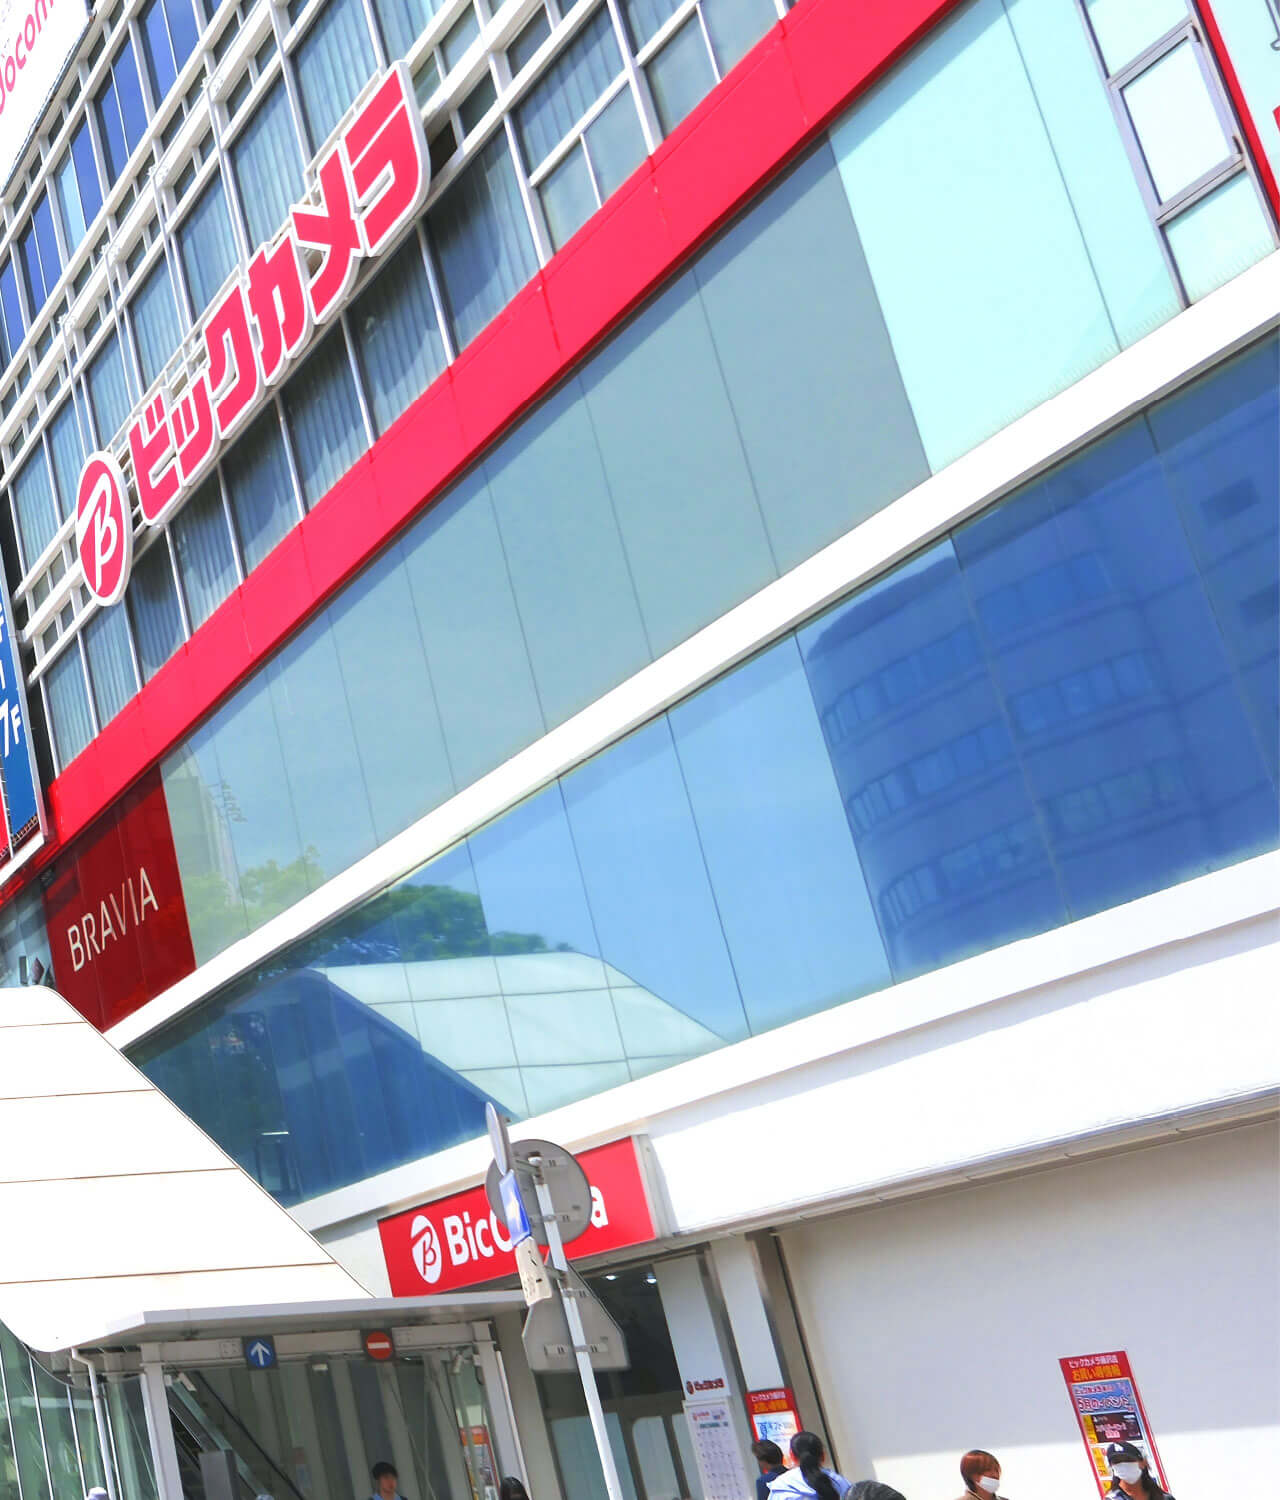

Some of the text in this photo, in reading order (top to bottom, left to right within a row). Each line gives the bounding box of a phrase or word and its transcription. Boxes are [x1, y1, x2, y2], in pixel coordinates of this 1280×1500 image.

[127, 62, 428, 524] ビックカメラ
[67, 866, 159, 972] BRAVIA
